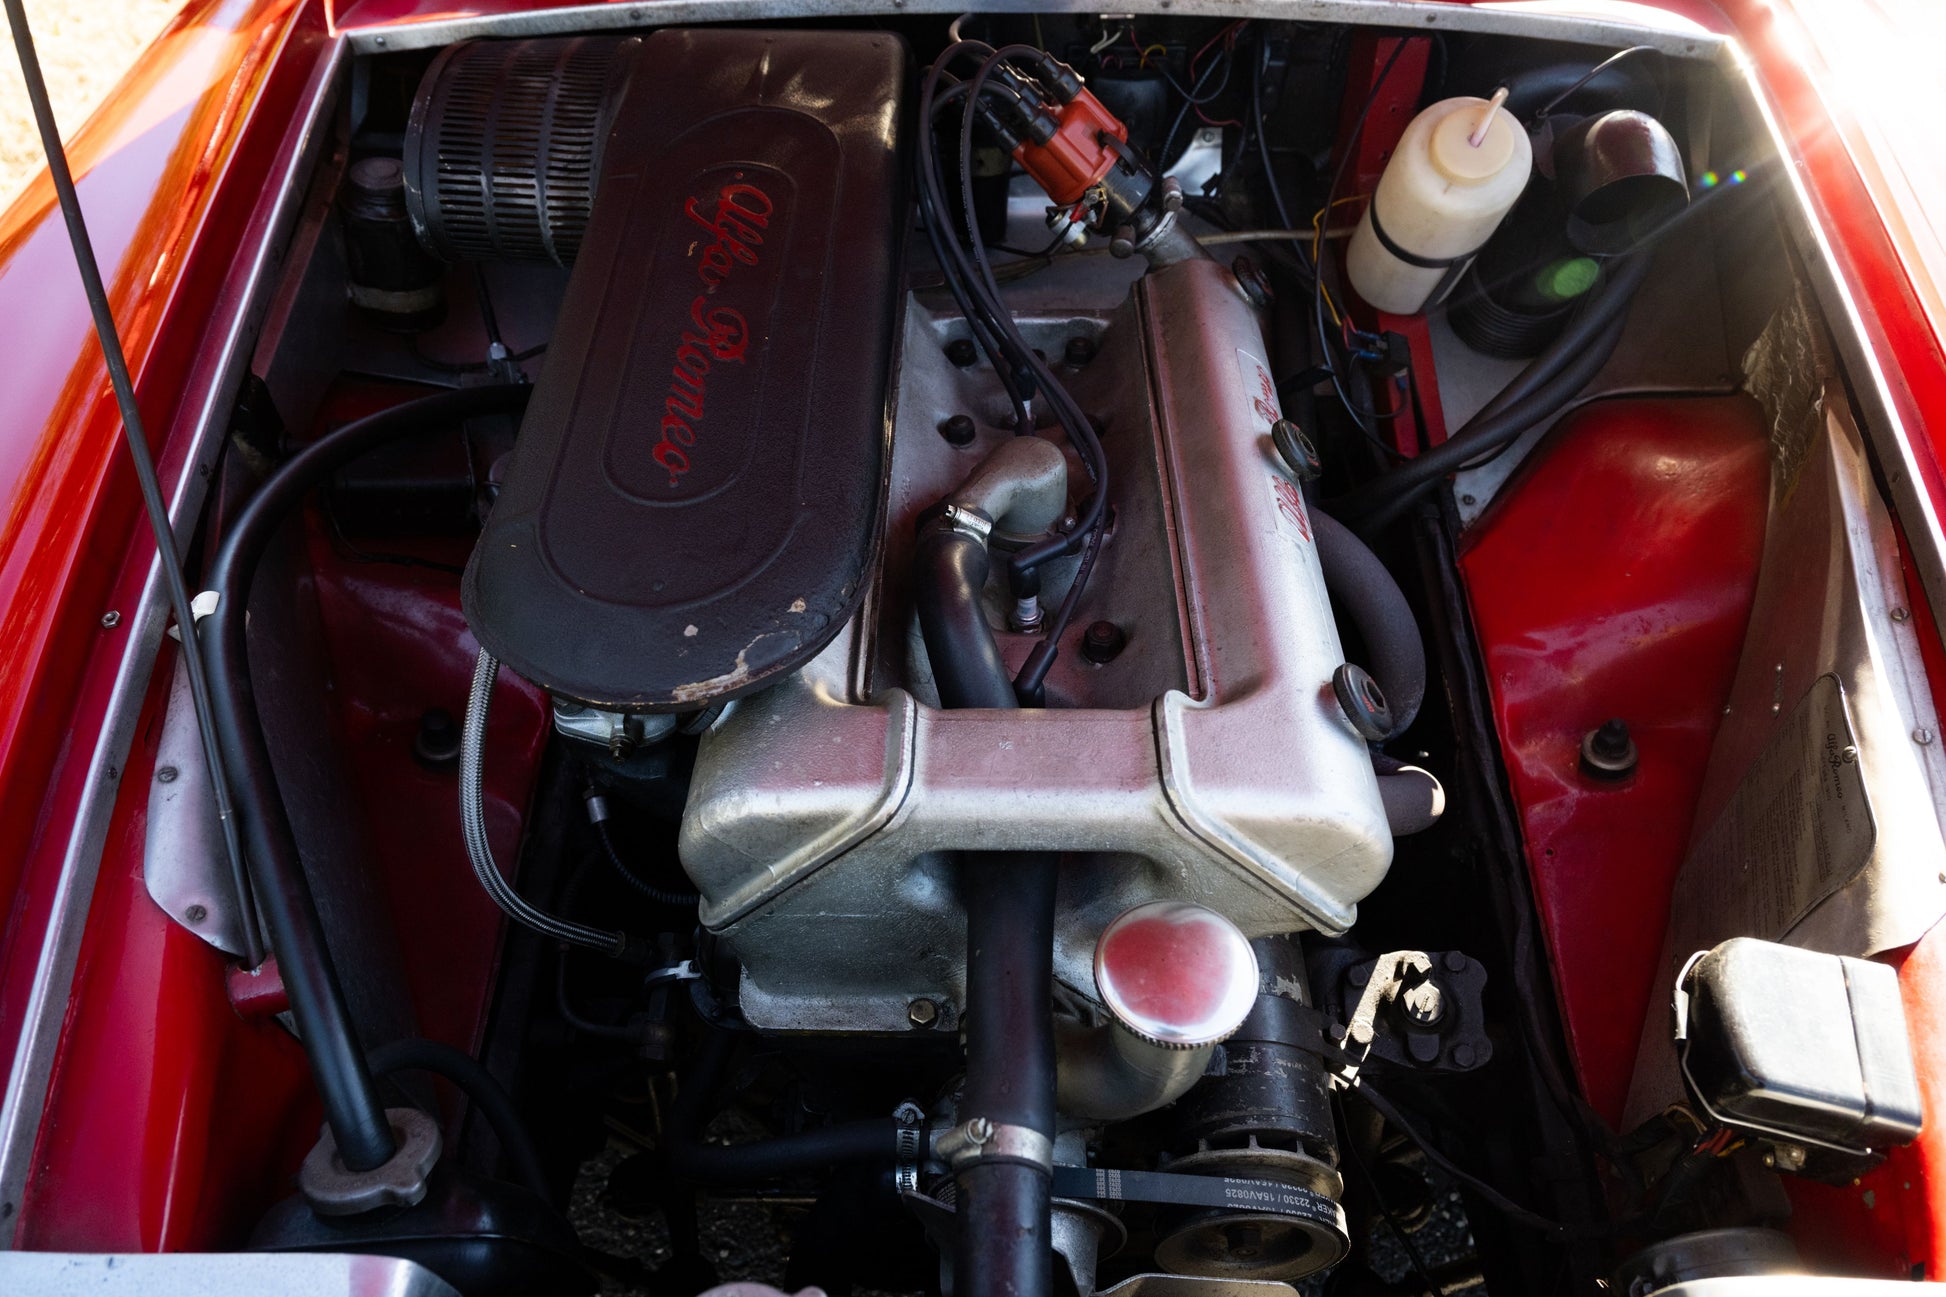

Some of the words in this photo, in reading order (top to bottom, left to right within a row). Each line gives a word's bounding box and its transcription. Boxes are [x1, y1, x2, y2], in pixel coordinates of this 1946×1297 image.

[685, 184, 773, 285] Alfa
[653, 296, 749, 473] Romeo
[1824, 733, 1838, 756] Alfa
[1829, 754, 1844, 799] Romeo
[1225, 1187, 1275, 1203] 15AV0825
[1283, 1195, 1310, 1207] 22330
